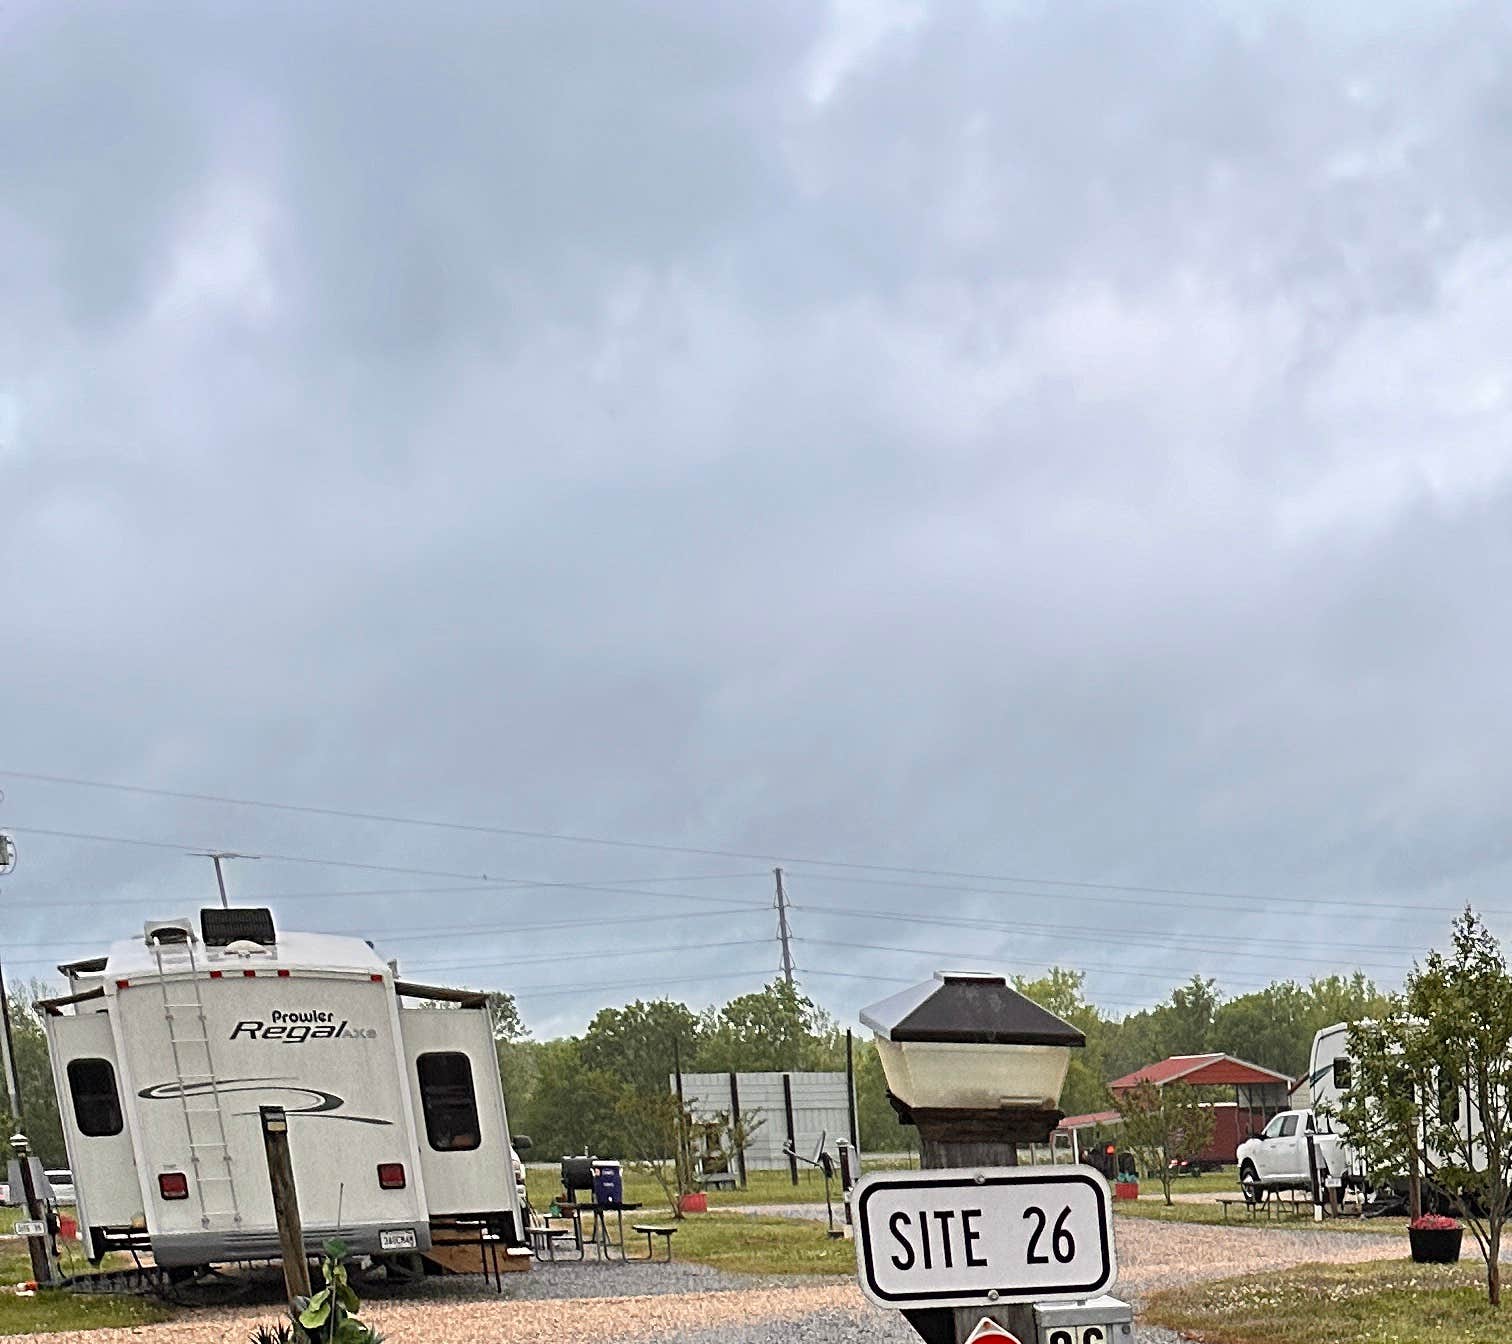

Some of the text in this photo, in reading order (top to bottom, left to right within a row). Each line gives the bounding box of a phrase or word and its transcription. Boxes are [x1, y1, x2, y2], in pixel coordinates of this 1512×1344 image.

[271, 1009, 335, 1023] Prowler
[229, 1020, 348, 1044] Regal
[889, 1205, 1076, 1271] SITE 26
